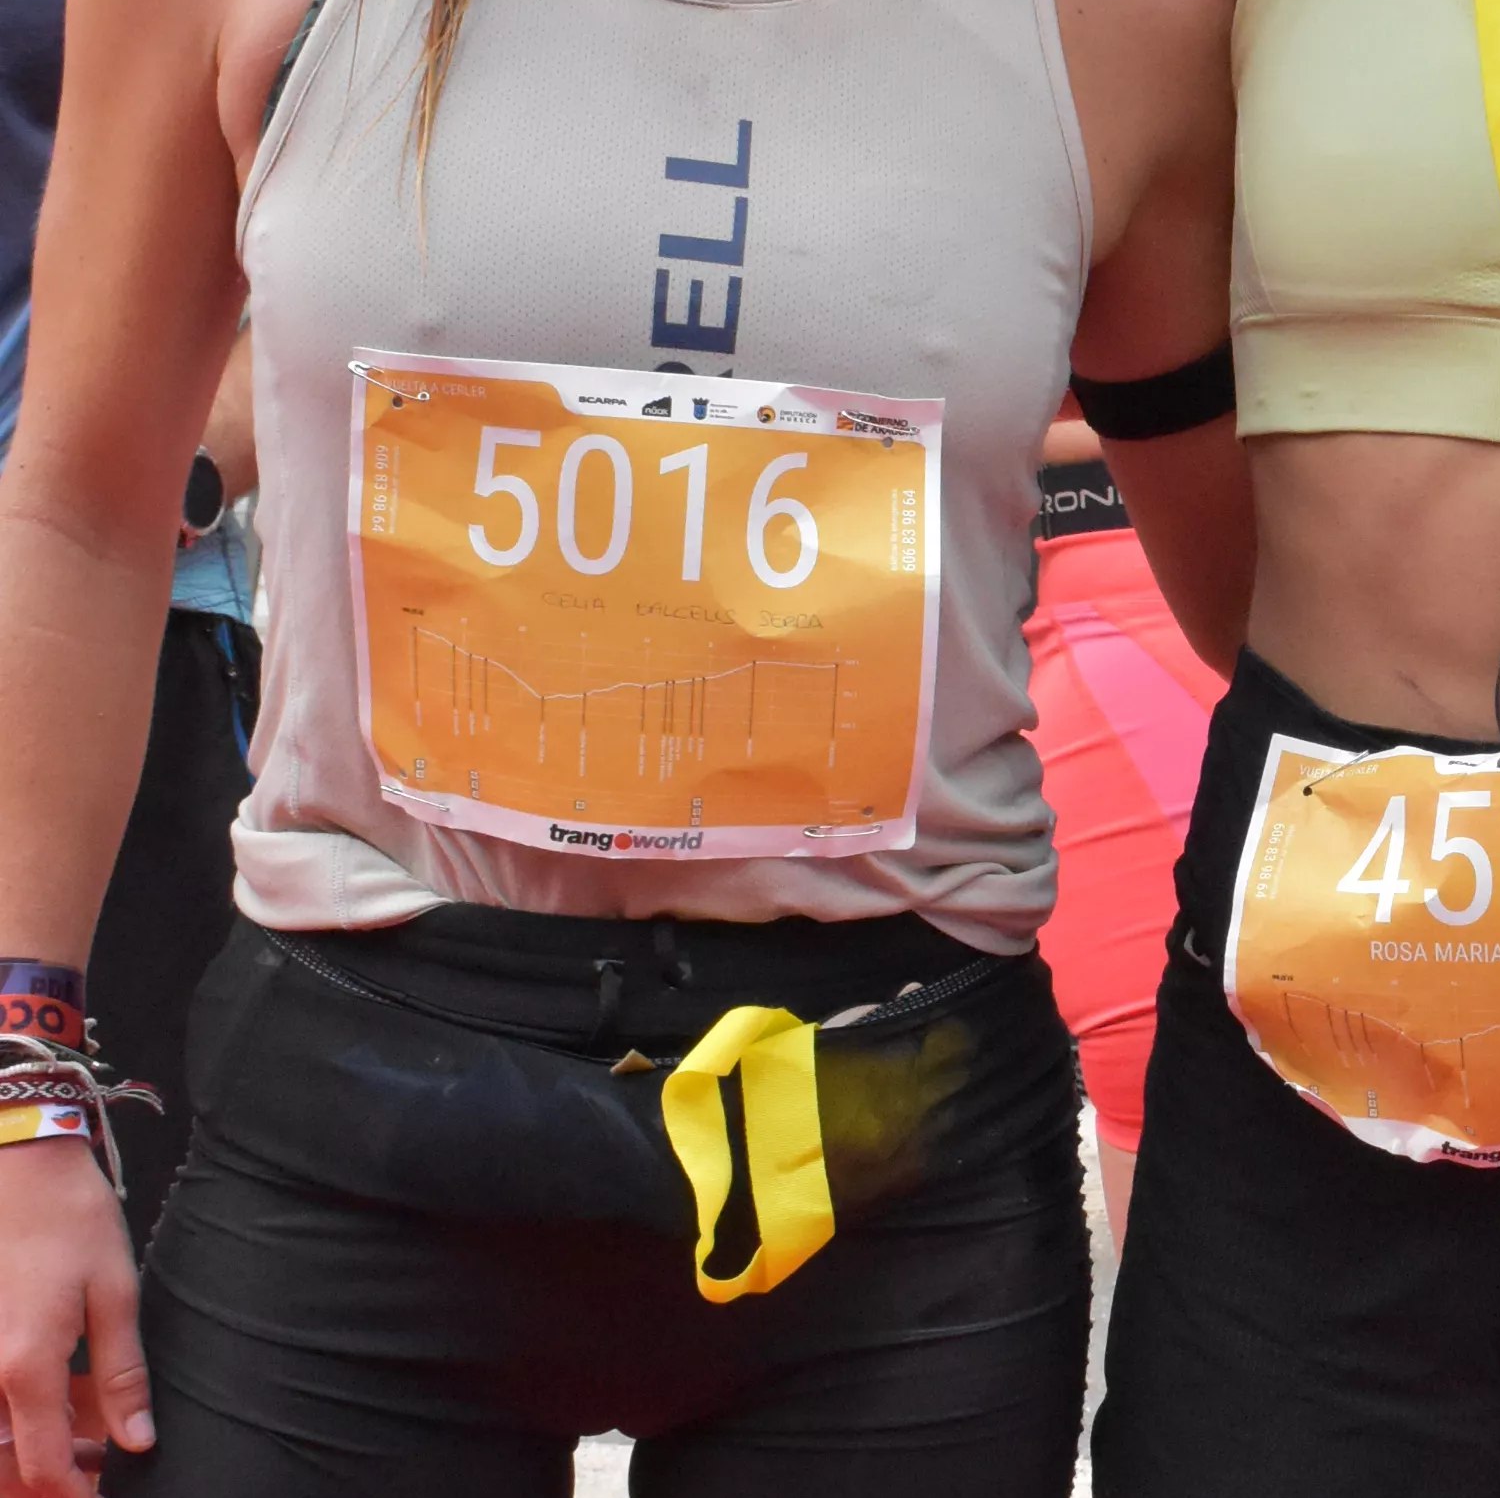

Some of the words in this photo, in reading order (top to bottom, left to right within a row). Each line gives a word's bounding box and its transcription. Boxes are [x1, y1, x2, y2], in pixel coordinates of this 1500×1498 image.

[650, 119, 752, 379] ELL
[443, 383, 486, 398] CERLER
[578, 396, 628, 406] SCARPA
[854, 423, 869, 433] DE
[374, 445, 389, 470] 606
[373, 474, 389, 490] 83
[372, 494, 388, 511] 98
[902, 489, 916, 505] 64
[467, 425, 820, 589] 5016
[371, 515, 386, 532] 64
[902, 509, 916, 525] 98
[902, 529, 916, 545] 83
[902, 548, 916, 571] 606
[1271, 823, 1285, 844] 606
[1264, 847, 1278, 862] 83
[1259, 864, 1273, 880] 98
[1255, 883, 1268, 898] 64
[1370, 940, 1428, 962] ROSA
